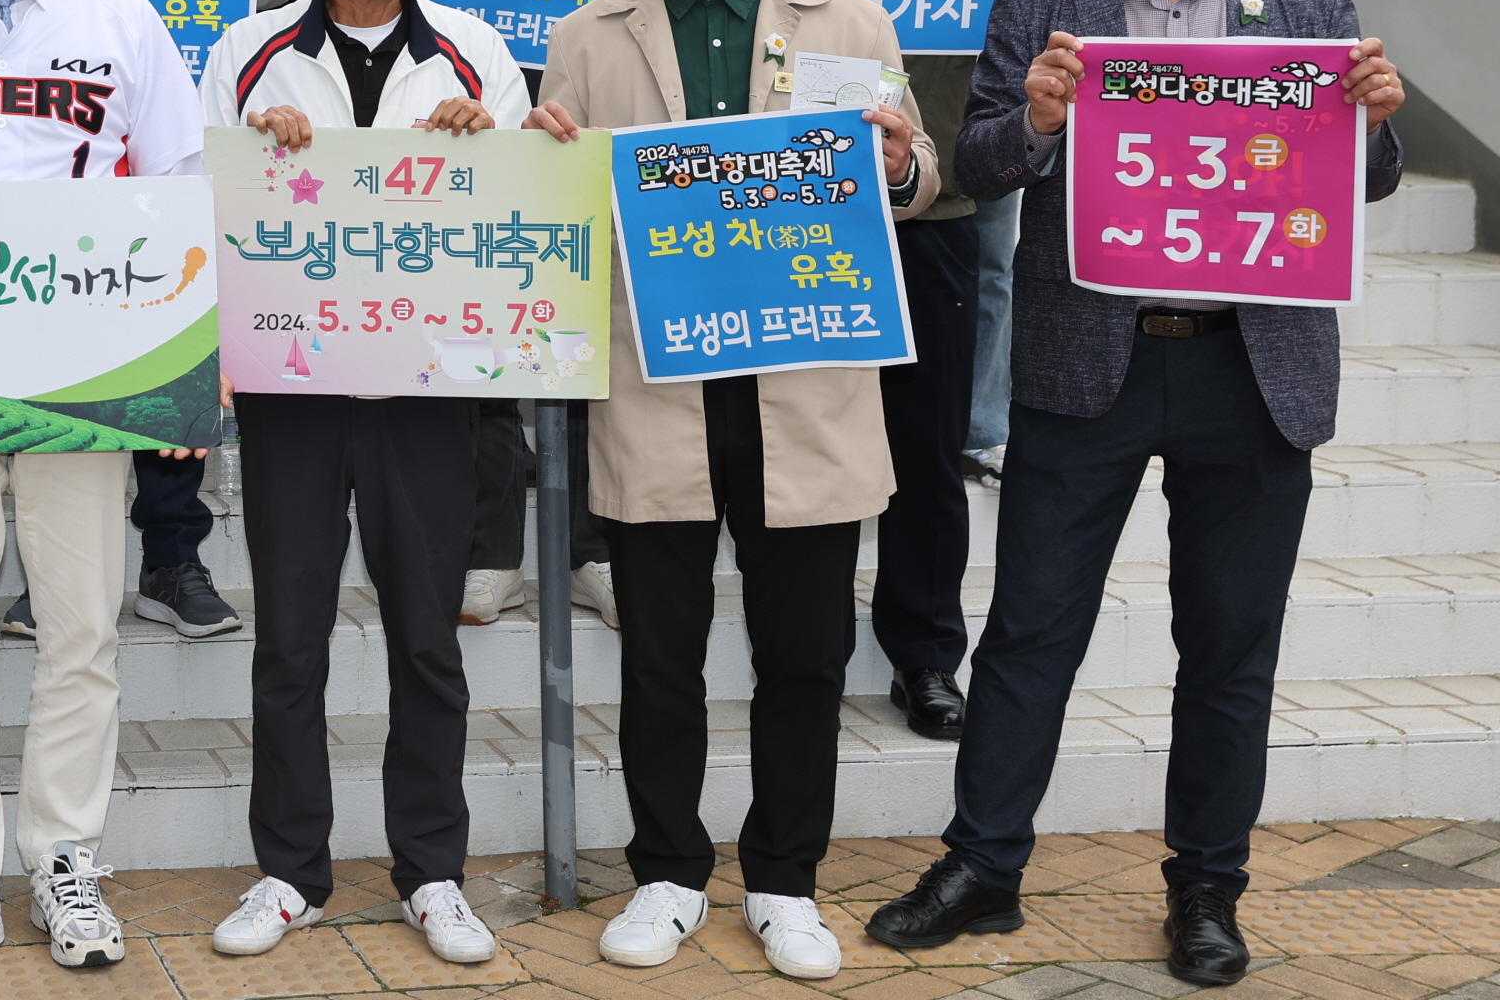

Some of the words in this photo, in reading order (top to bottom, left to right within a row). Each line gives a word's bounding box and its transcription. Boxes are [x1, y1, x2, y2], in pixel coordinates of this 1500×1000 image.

[1104, 60, 1149, 73] 2024
[1152, 65, 1181, 73] 제47회
[1099, 74, 1312, 108] 보성다향대축제
[636, 144, 679, 163] 2024
[681, 145, 709, 156] 제47회
[637, 149, 834, 193] 보성다향대축제
[238, 210, 591, 290] 보성다향대축제
[649, 221, 715, 258] 보성
[726, 218, 833, 250] 차(茶)의
[790, 251, 872, 291] 유혹,
[664, 309, 752, 356] 보성의
[760, 304, 881, 342] 프러포즈
